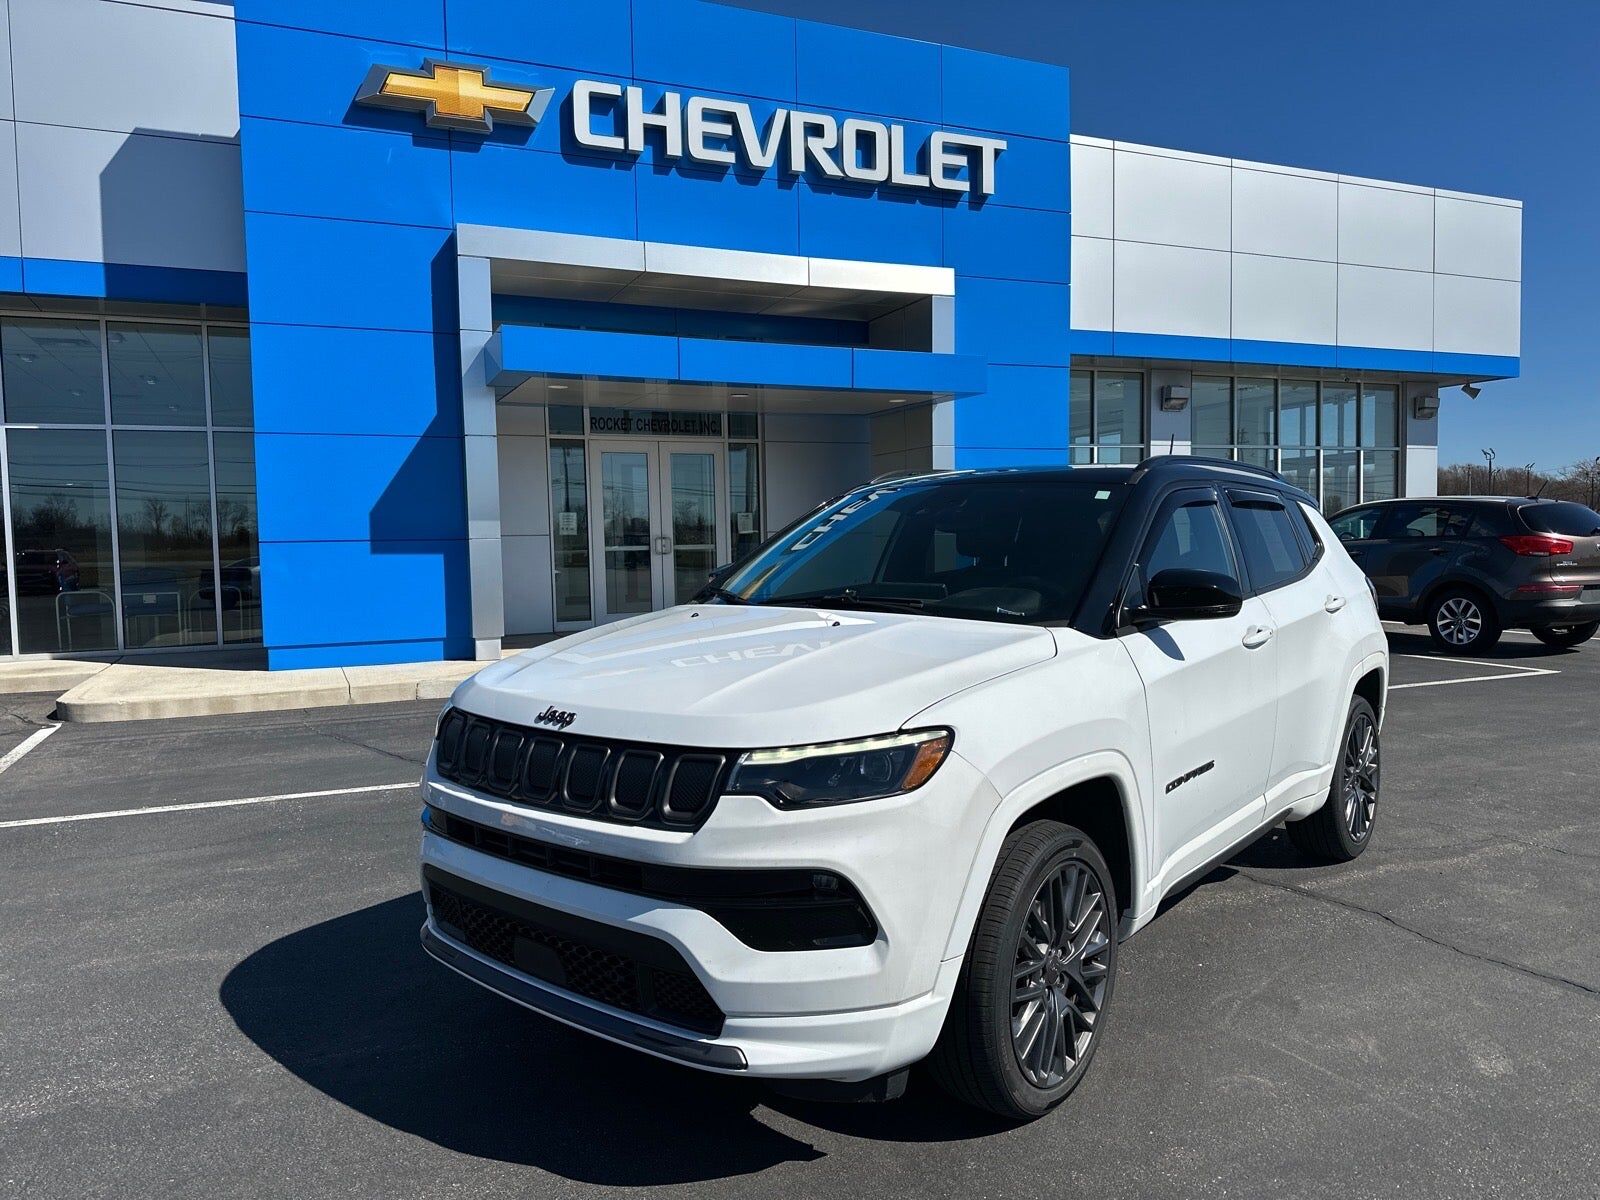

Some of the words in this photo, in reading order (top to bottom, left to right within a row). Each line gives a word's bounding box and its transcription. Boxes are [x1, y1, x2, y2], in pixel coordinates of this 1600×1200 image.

[573, 79, 1008, 196] CHEVROLET
[590, 416, 633, 431] ROCKET
[533, 705, 577, 730] Jeep
